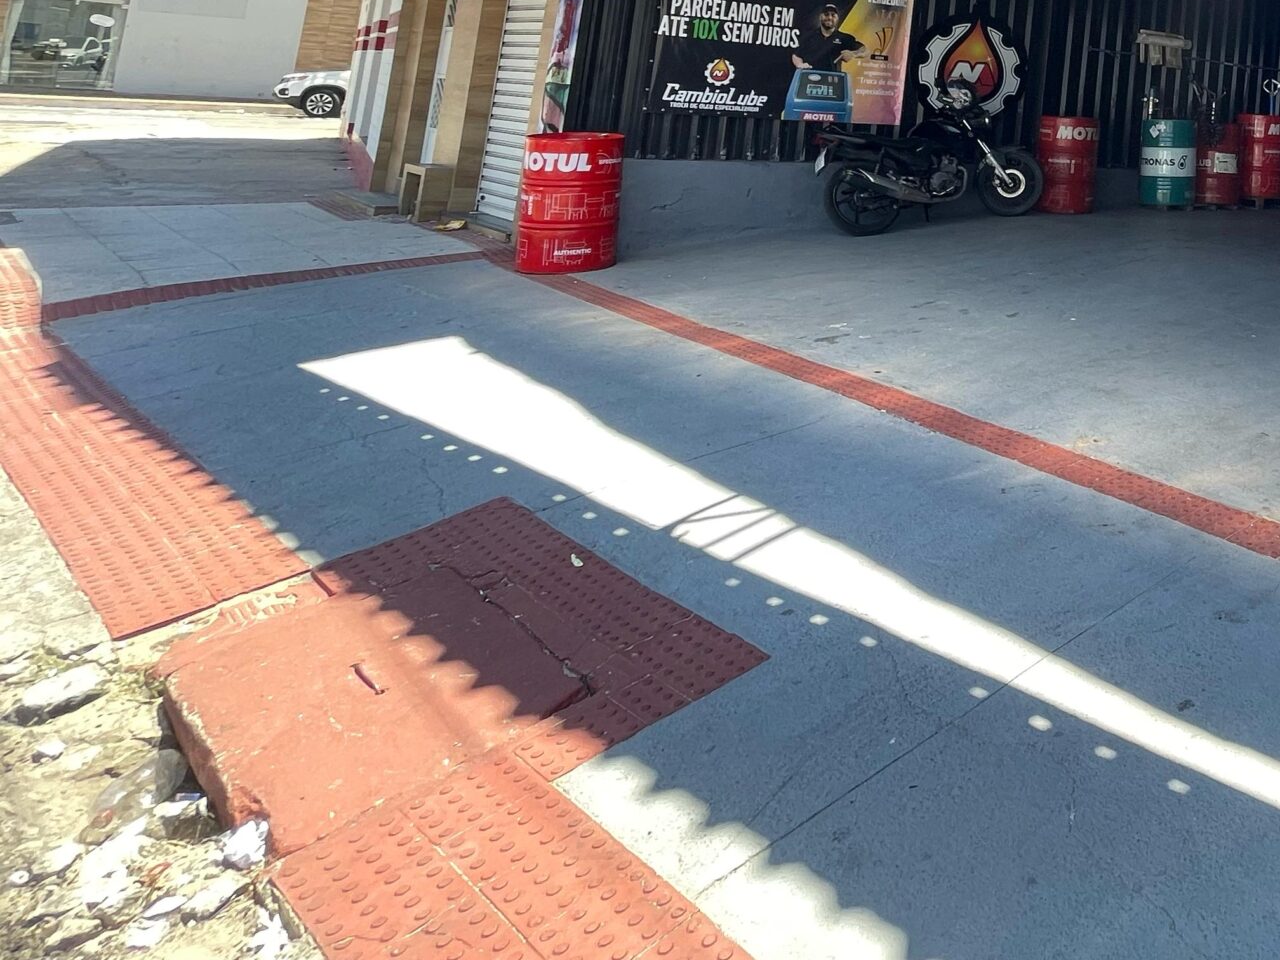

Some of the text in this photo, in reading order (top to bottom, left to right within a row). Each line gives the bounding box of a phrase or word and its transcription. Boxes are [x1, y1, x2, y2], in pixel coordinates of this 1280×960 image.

[773, 6, 794, 28] EM
[658, 12, 800, 48] ATÉ 10X SEM JUROS
[662, 83, 768, 107] CambioLube
[803, 113, 834, 121] MOTUL
[1056, 126, 1098, 140] MOT
[553, 247, 591, 256] AUTHENTIC
